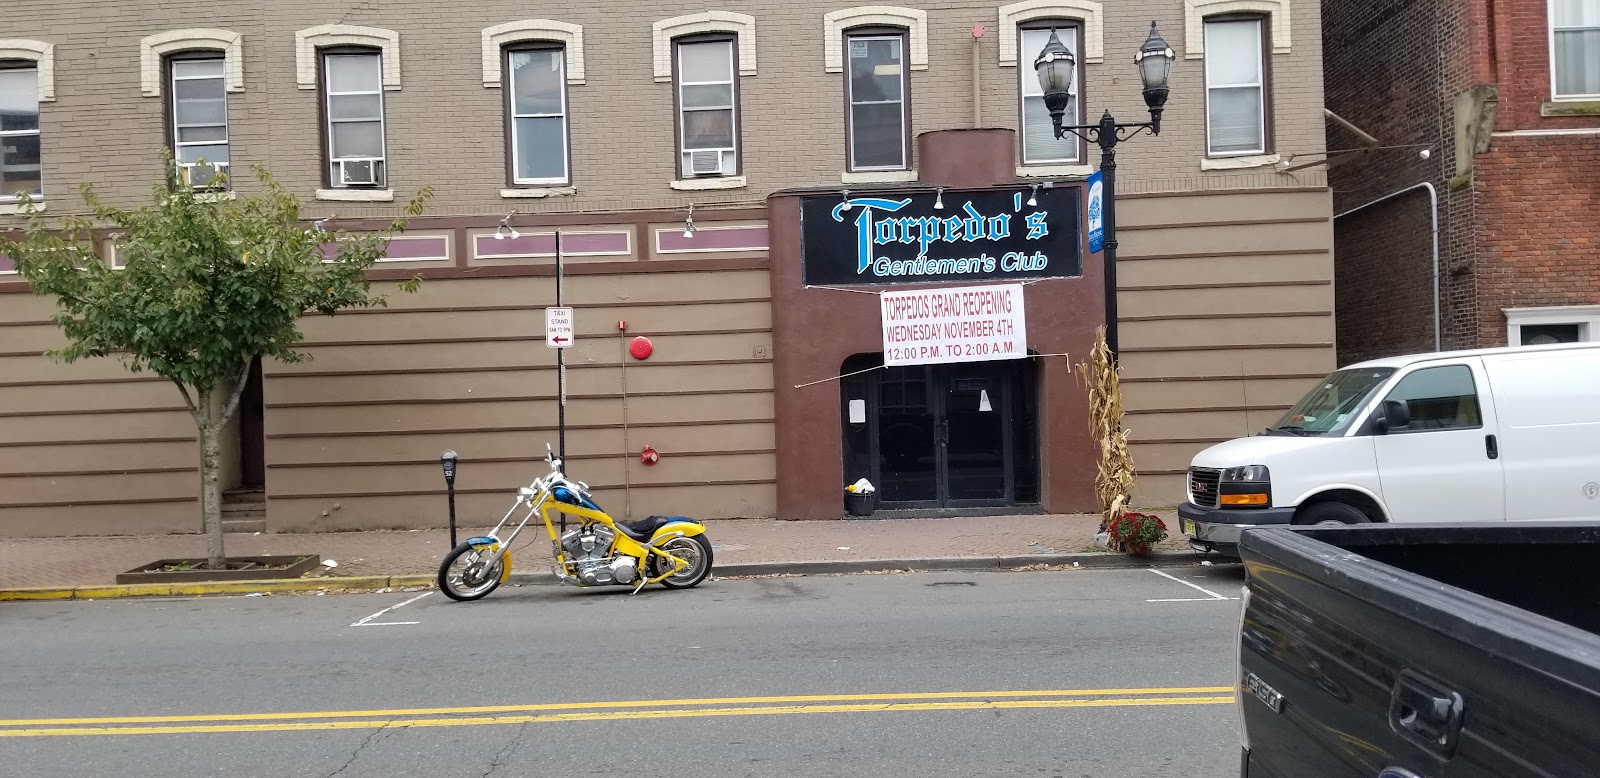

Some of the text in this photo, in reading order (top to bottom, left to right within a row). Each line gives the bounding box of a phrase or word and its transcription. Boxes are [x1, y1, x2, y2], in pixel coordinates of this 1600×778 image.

[831, 192, 1049, 275] Torpedo's
[873, 251, 1048, 277] Gentlemen's Club
[884, 290, 1012, 321] TORPEDOS GRAND REOPENING
[886, 318, 1014, 343] WEDNESDAY NOVEMBER 4TH
[887, 347, 917, 361] 12:00
[920, 345, 943, 359] P.M.
[946, 344, 962, 357] TO
[965, 343, 989, 356] 2:00
